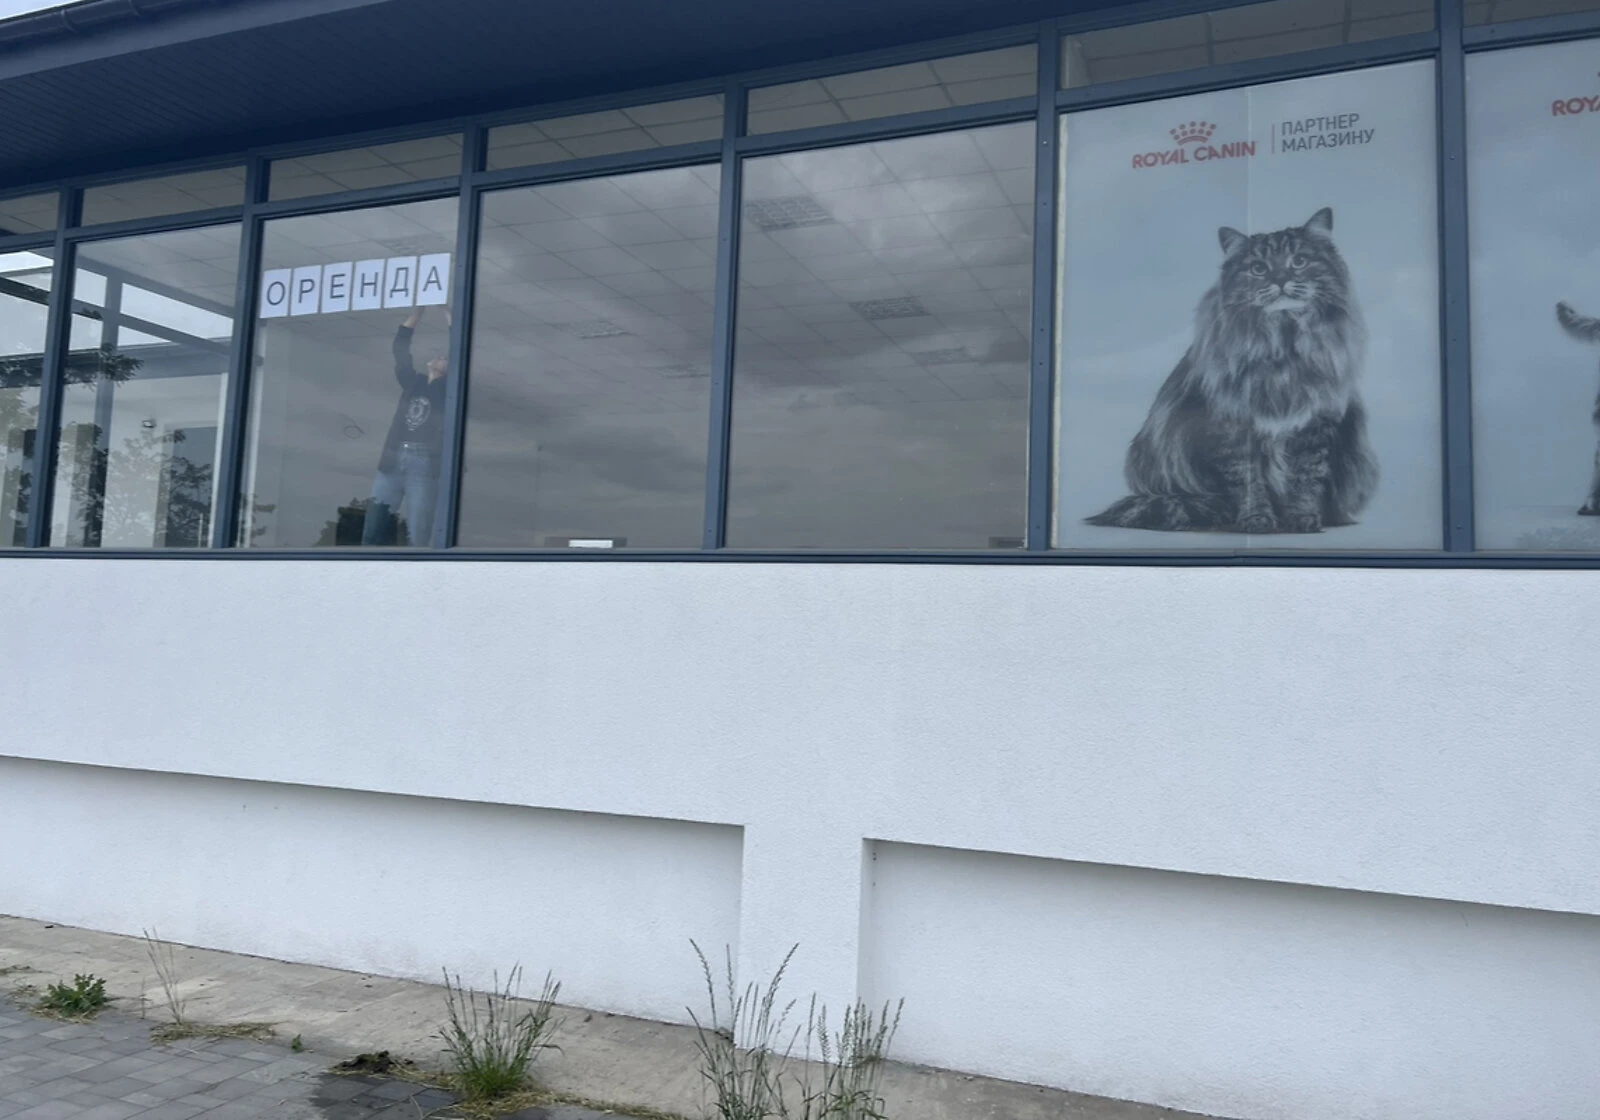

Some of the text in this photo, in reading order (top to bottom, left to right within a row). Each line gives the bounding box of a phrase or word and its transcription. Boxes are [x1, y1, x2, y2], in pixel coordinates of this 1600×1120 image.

[1282, 113, 1360, 136] ПАРТНЕР
[1282, 128, 1375, 153] МАГАЗИНУ
[1132, 141, 1256, 168] ROYAL CANIN
[266, 265, 442, 306] ОРЕНДА
